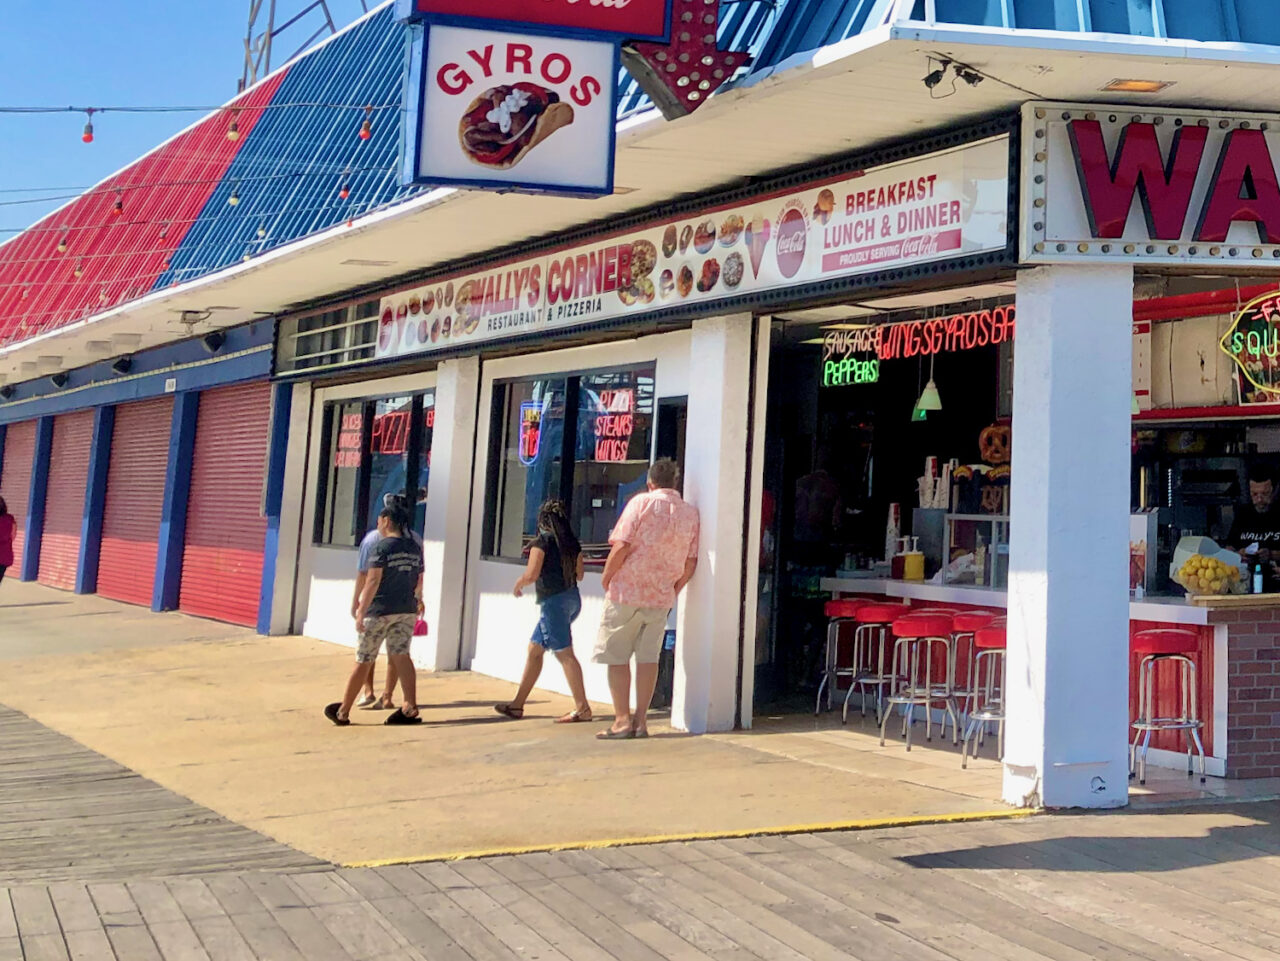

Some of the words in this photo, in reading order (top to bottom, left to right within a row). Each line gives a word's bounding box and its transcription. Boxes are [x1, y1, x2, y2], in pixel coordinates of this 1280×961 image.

[437, 43, 601, 106] GYROS
[845, 174, 937, 216] BREAKFAST
[823, 218, 876, 249] LUNCH
[880, 214, 892, 238] &
[897, 200, 961, 235] DINNER
[840, 250, 871, 266] PROUDLY
[870, 244, 900, 260] SERVING
[470, 263, 542, 319] WALLY'S
[547, 244, 633, 306] CORNER
[487, 309, 543, 331] RESTAURANT
[557, 298, 603, 318] PIZZERIA
[824, 329, 876, 361] SAUSAGE
[879, 320, 932, 360] WINGS
[931, 309, 991, 354] GYROS
[824, 358, 879, 386] PEPPERS
[595, 414, 632, 436] STEAKS
[595, 439, 628, 462] WINGS
[1240, 532, 1280, 541] WALLY'S
